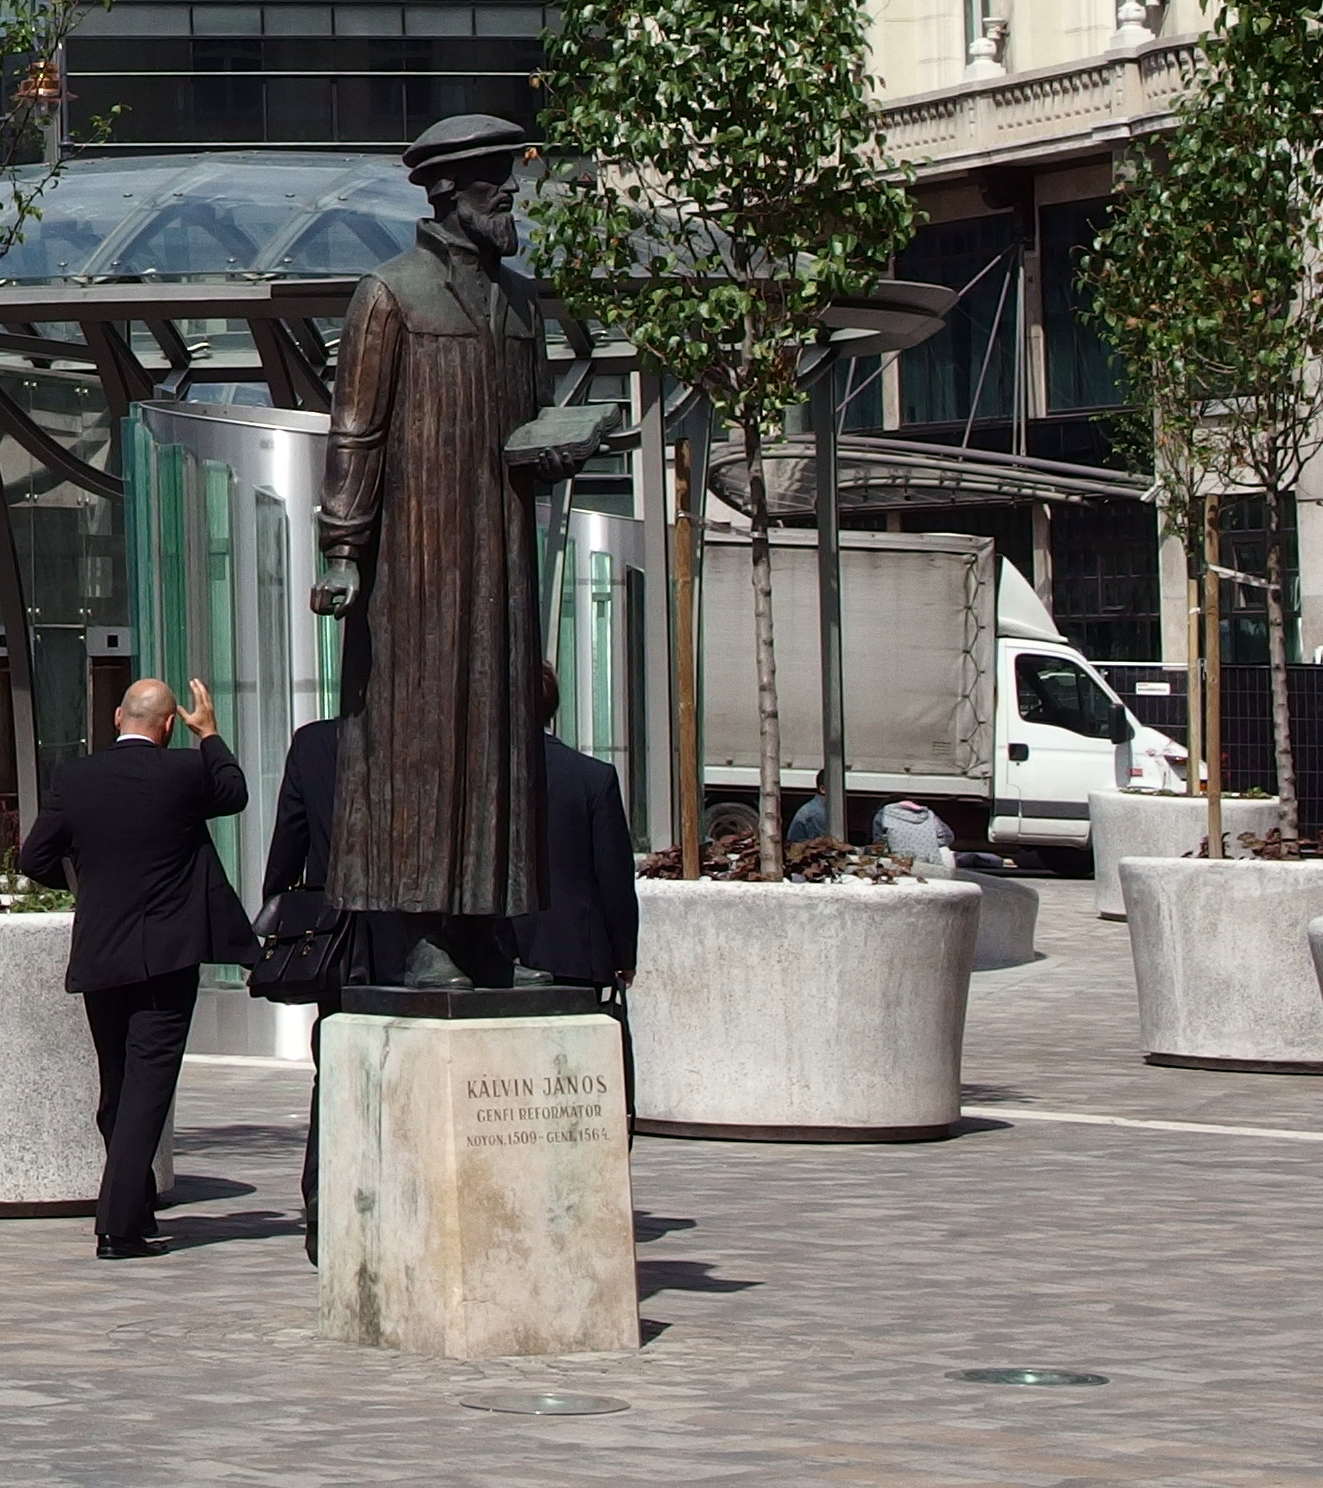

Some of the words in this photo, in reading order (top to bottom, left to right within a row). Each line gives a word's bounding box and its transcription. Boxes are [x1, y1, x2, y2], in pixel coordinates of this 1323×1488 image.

[467, 1074, 534, 1099] KÁLVIN
[543, 1071, 608, 1096] JÁNOS
[477, 1108, 514, 1123] GENFI
[519, 1103, 603, 1121] REFORMÁTOR
